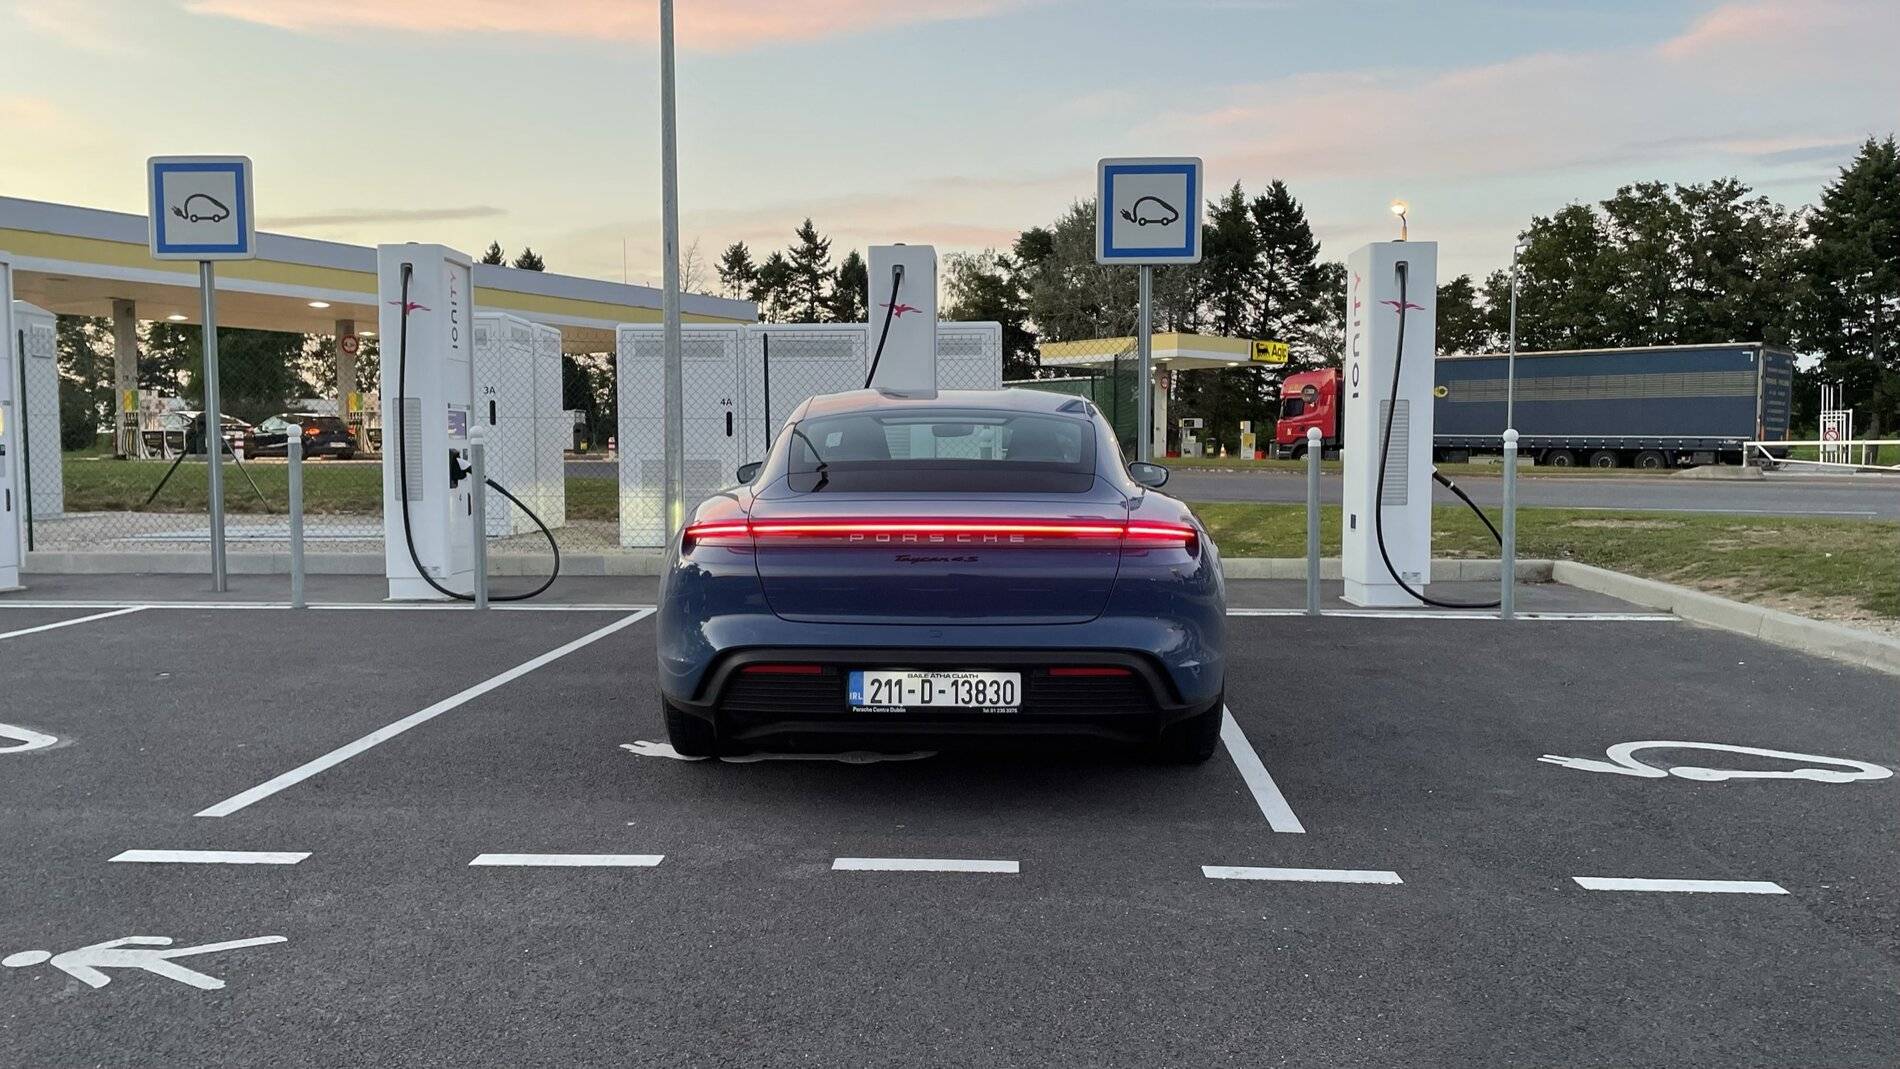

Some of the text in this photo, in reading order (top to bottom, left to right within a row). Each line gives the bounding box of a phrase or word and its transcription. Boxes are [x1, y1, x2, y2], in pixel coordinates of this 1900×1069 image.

[450, 270, 459, 349] IONITY
[1352, 271, 1361, 399] IONITY
[1272, 344, 1287, 360] Agip
[483, 386, 496, 395] 3A
[720, 398, 733, 406] 4A
[849, 534, 1025, 543] PORSCHE
[895, 554, 949, 565] Taycan
[849, 692, 863, 701] IRL
[870, 678, 1015, 705] 211-D-13830
